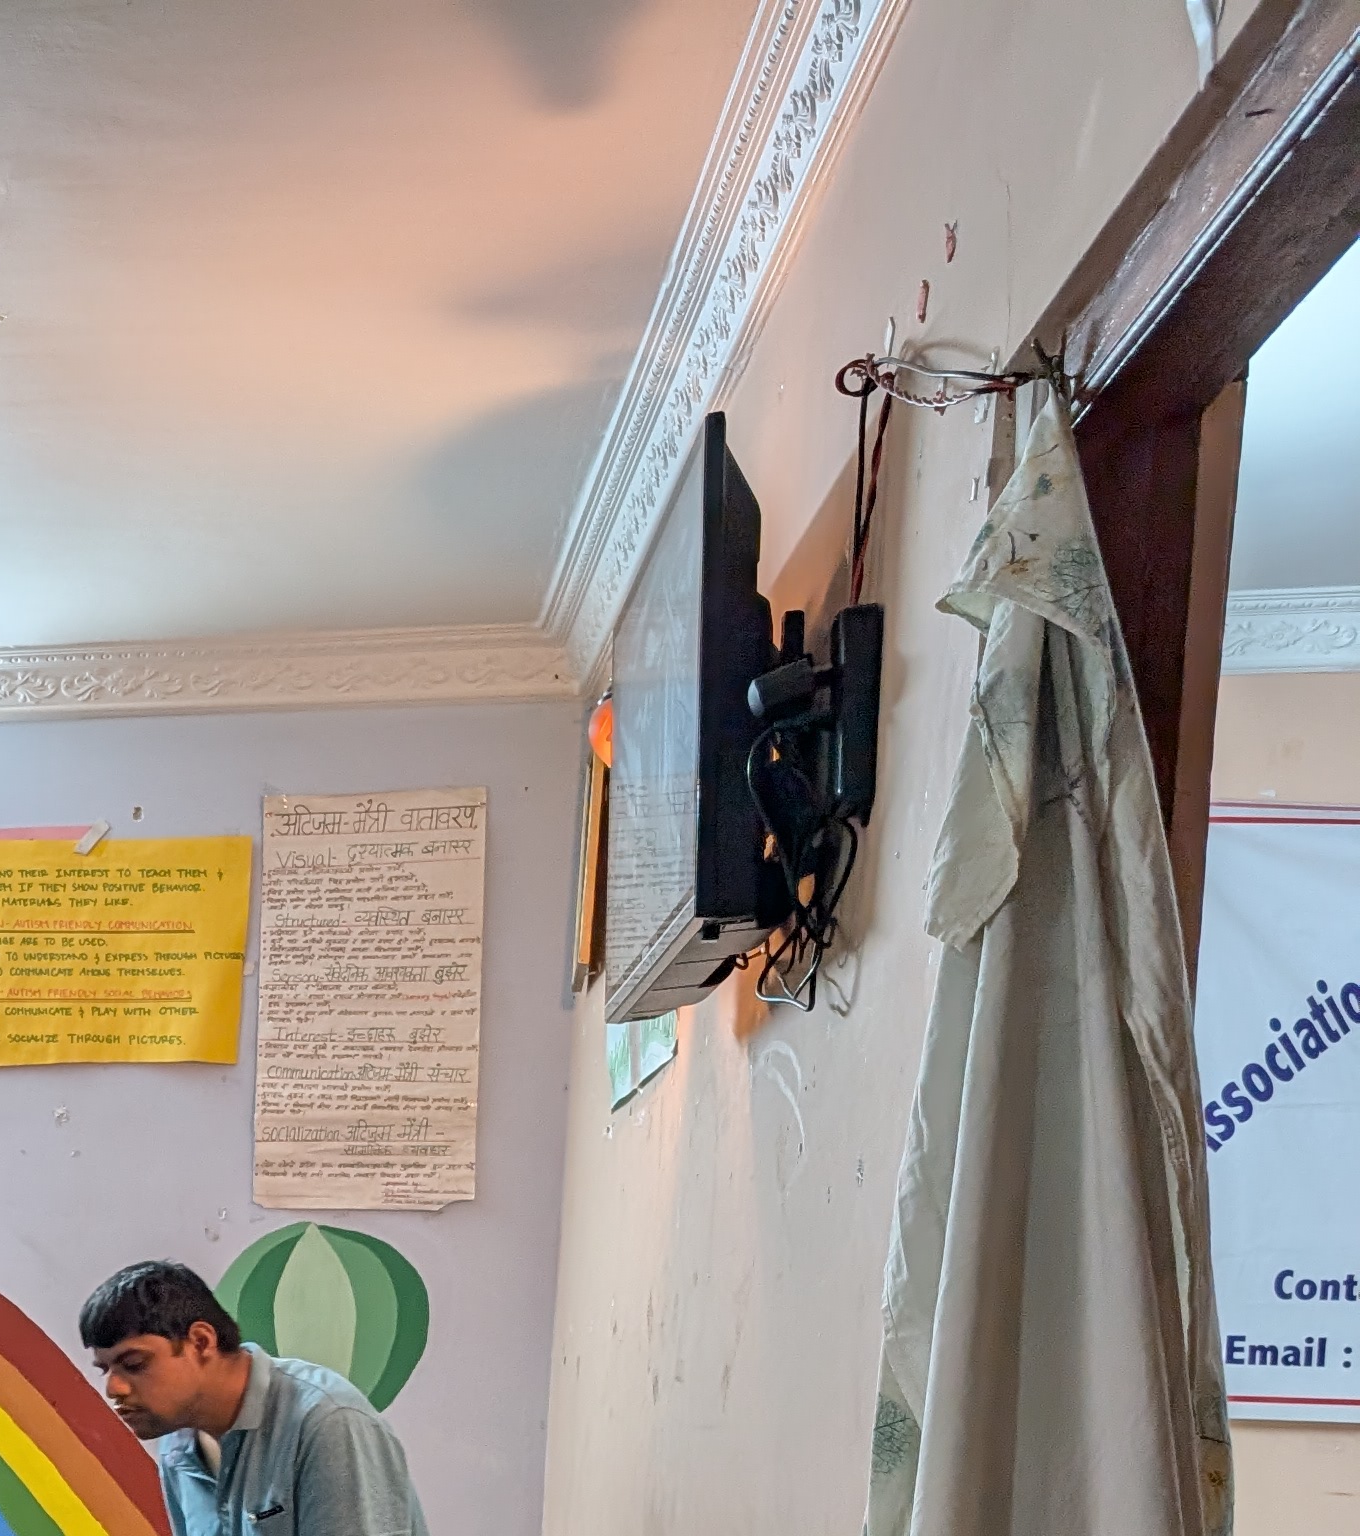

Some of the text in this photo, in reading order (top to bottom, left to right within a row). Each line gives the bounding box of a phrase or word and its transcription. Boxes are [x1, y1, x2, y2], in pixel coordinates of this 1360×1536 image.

[18, 869, 49, 878] THEIR
[55, 868, 110, 878] INTEREST
[116, 868, 131, 878] TO
[138, 868, 171, 878] TEACH
[177, 868, 207, 878] THEM
[18, 883, 33, 892] IF
[39, 883, 66, 892] THEY
[72, 883, 98, 892] SHOW
[102, 883, 145, 892] POSITIVE
[152, 883, 205, 893] BEHAVIOR.
[69, 898, 97, 907] THEY
[104, 898, 133, 907] LIKE.
[14, 919, 49, 929] AUTISM
[53, 919, 102, 930] FRIENDLY
[108, 920, 193, 930] COMMUNICATION
[20, 937, 38, 946] ARE
[44, 937, 55, 945] TO
[61, 937, 74, 947] BE
[78, 938, 108, 947] USED.
[5, 951, 18, 961] TO
[23, 952, 88, 961] UNDERSTAND
[105, 952, 148, 962] EXPRESS
[9, 967, 73, 977] COMMUNICATE
[79, 968, 111, 977] AMONG
[117, 967, 185, 977] THEMSELVES.
[6, 988, 41, 998] AUTISM
[47, 988, 97, 998] FRIENDLY
[4, 1006, 73, 1016] COMMUNICATE
[91, 1006, 117, 1017] PLAY
[123, 1007, 151, 1016] WITH
[159, 1006, 199, 1016] OTHER
[7, 1033, 59, 1044] SOCIALIZE
[67, 1033, 121, 1044] THROUGH
[128, 1034, 186, 1046] PICTURES.
[1205, 979, 1360, 1153] ssociatio
[1274, 1269, 1360, 1301] Cont
[1225, 1335, 1327, 1368] Email
